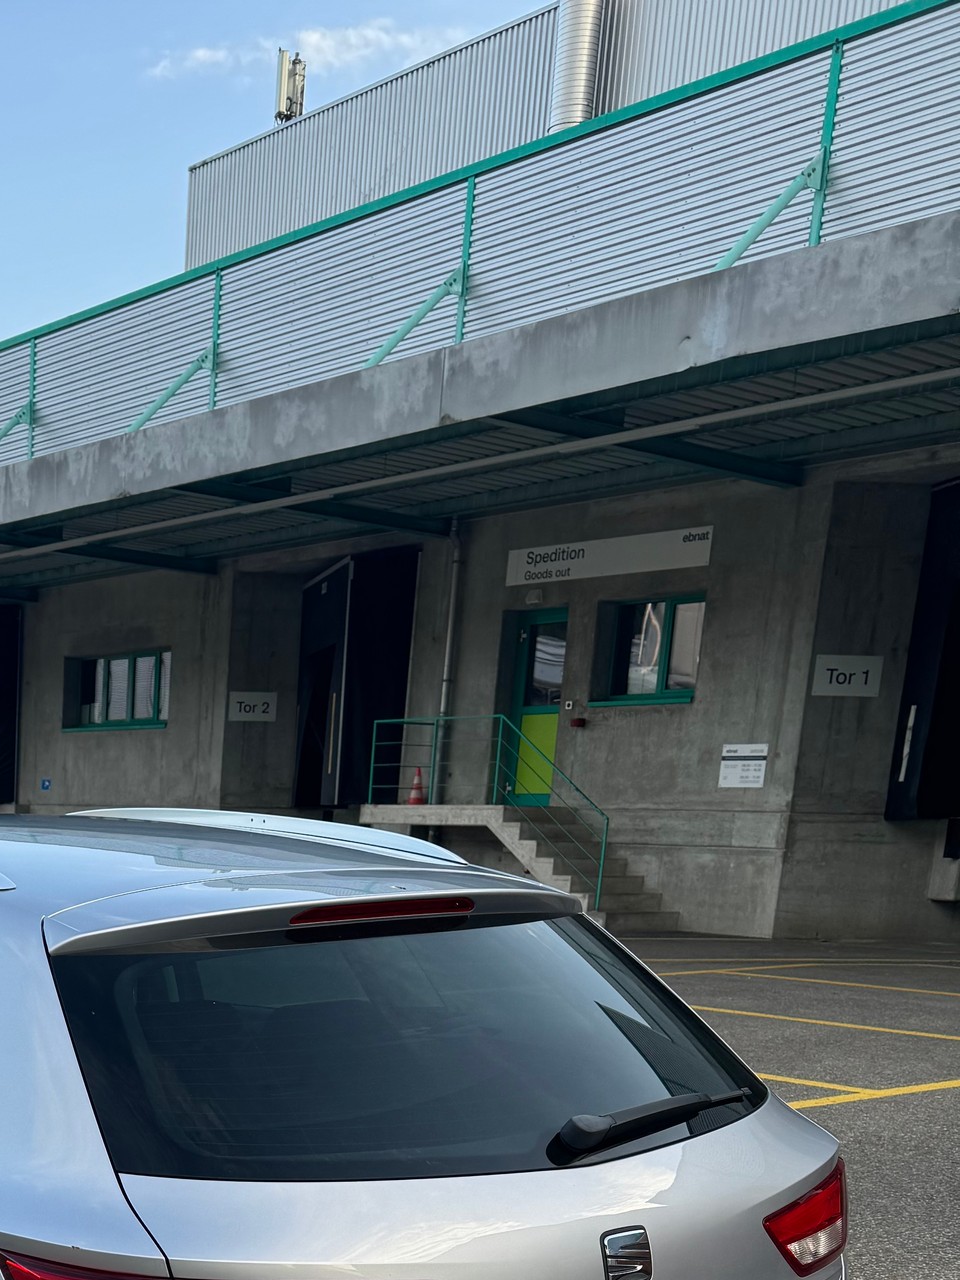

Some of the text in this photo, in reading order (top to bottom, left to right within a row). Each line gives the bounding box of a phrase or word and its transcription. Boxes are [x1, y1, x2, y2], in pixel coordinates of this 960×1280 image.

[682, 531, 710, 543] ebnat
[526, 547, 585, 566] Spedition
[524, 567, 570, 581] Goods out
[825, 668, 870, 685] Tor 1
[236, 701, 270, 714] Tor 2
